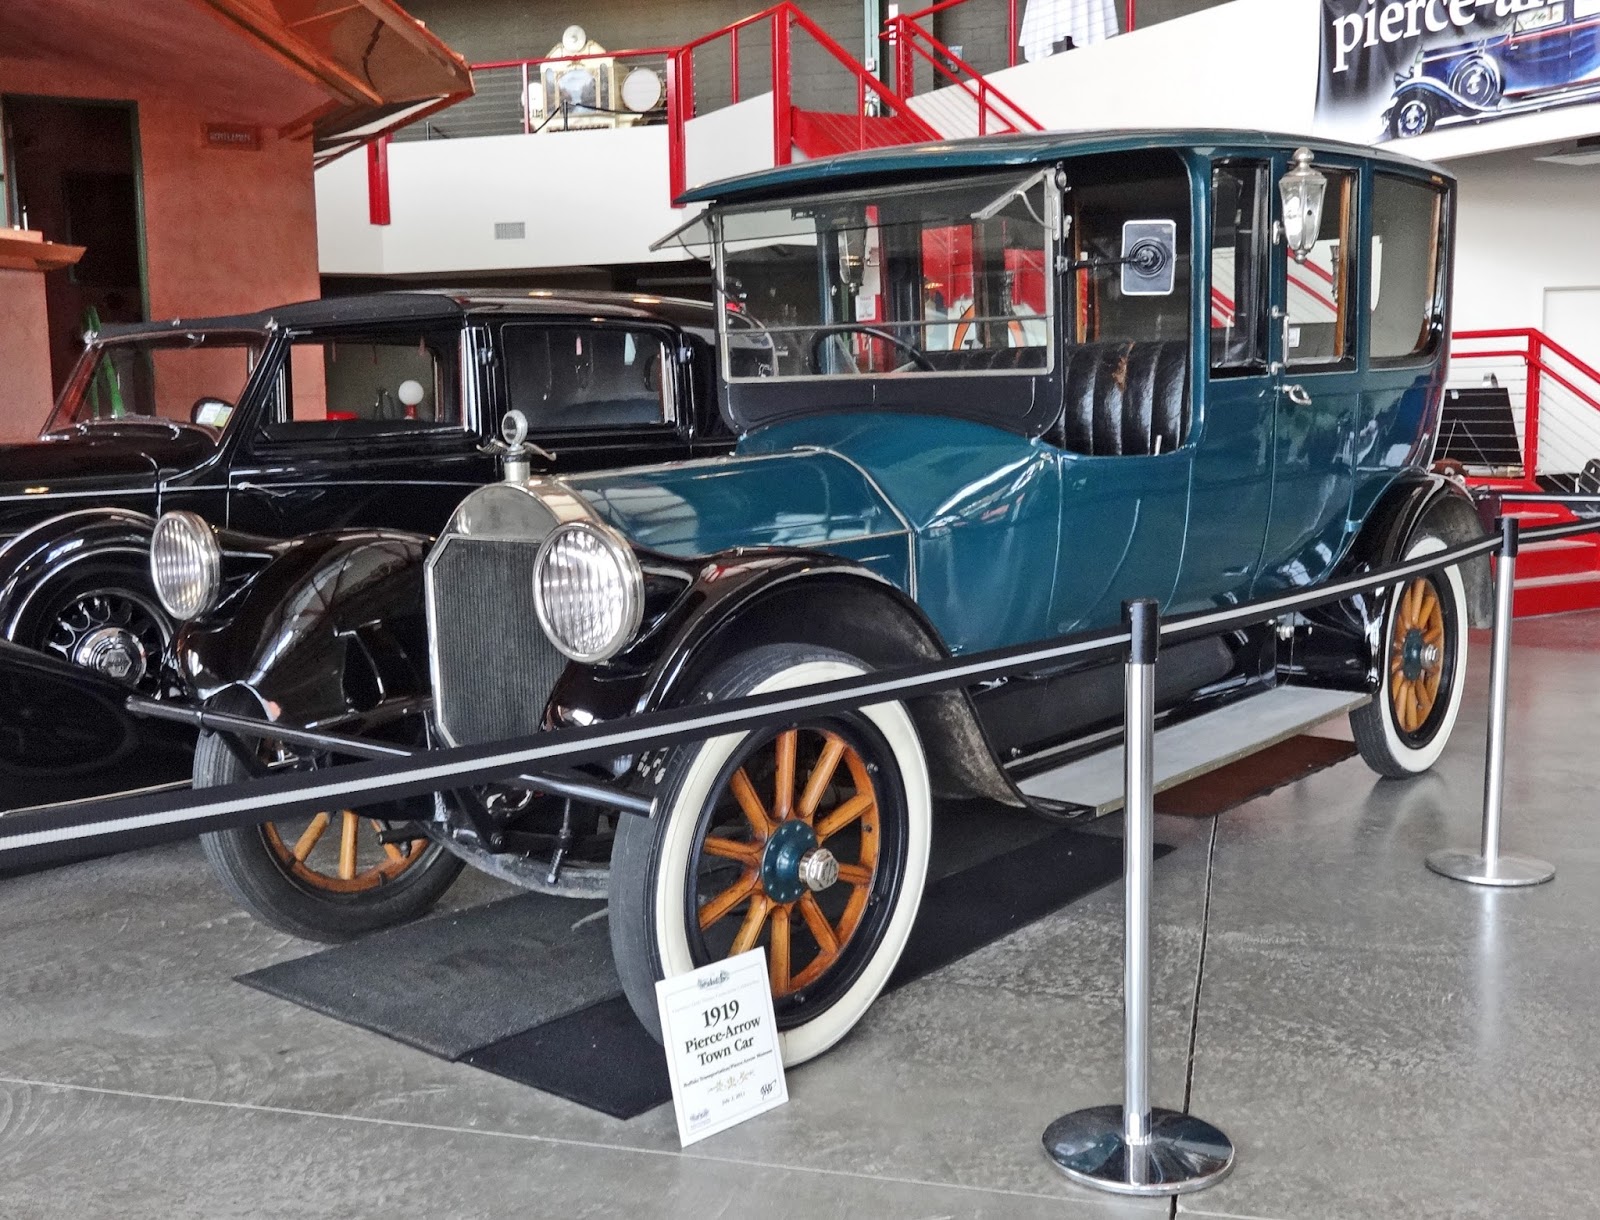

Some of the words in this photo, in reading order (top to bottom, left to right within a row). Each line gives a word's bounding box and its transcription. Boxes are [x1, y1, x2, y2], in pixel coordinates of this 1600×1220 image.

[1332, 0, 1564, 73] pierce-
[702, 999, 740, 1029] 1919
[685, 1016, 761, 1054] Pierce-Arrow
[697, 1046, 731, 1066] Town
[734, 1036, 754, 1051] Car
